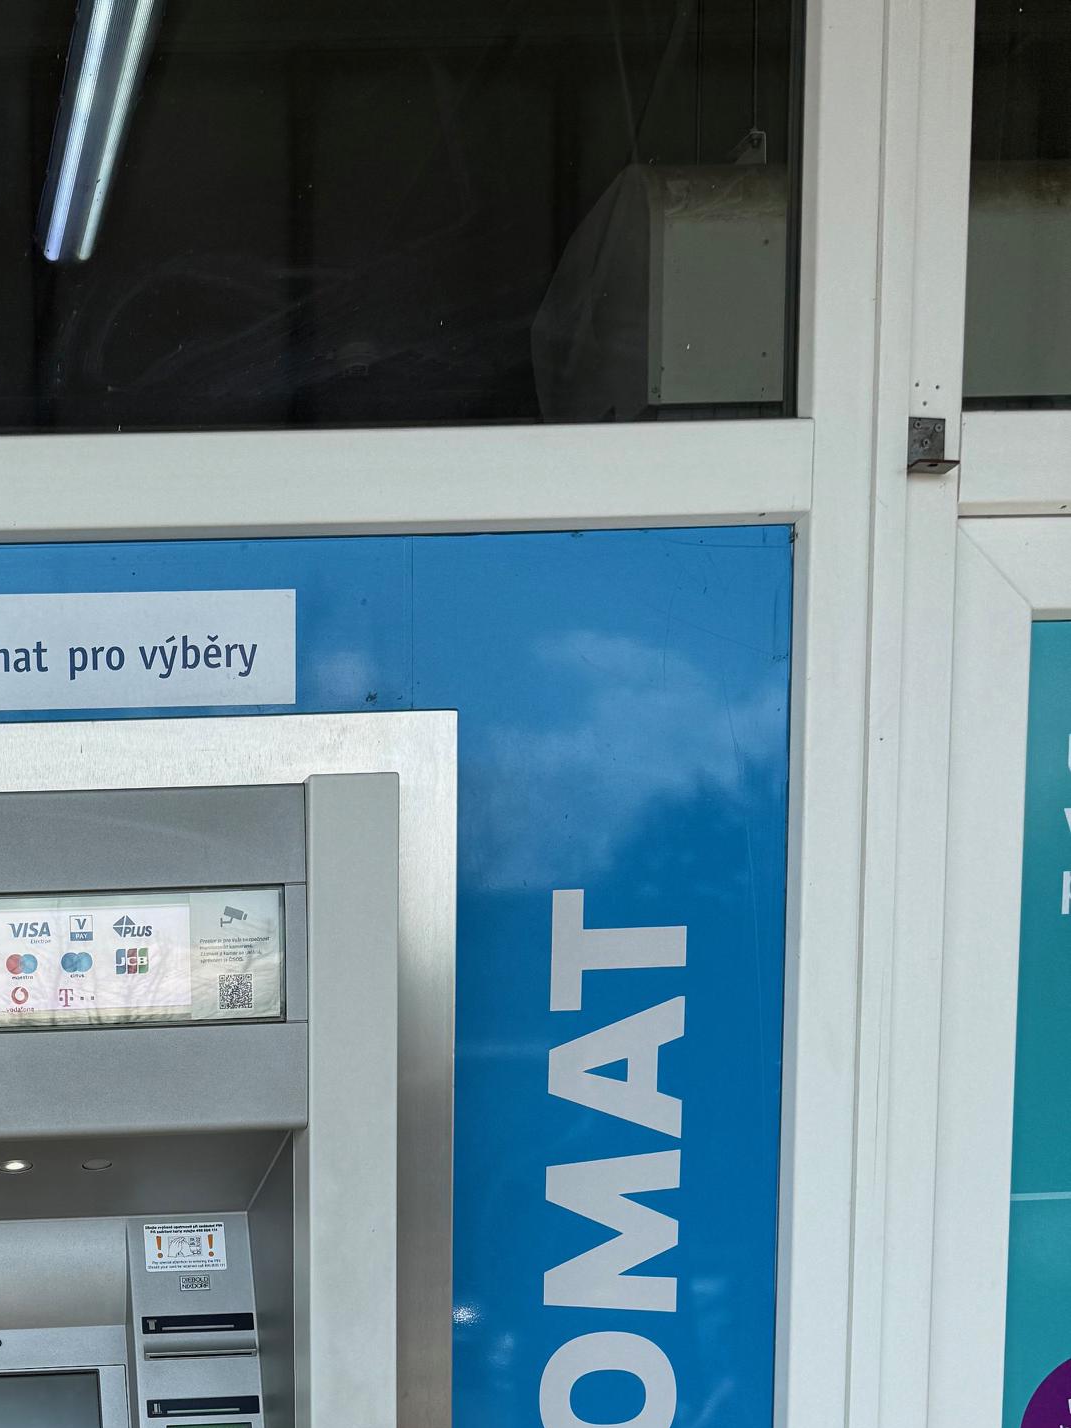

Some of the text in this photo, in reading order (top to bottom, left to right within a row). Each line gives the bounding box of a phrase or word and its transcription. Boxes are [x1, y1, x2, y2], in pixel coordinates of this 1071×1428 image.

[69, 645, 125, 681] pro
[138, 635, 258, 679] výběry
[8, 922, 52, 938] VISA
[74, 918, 87, 930] V
[123, 925, 152, 938] PLUS
